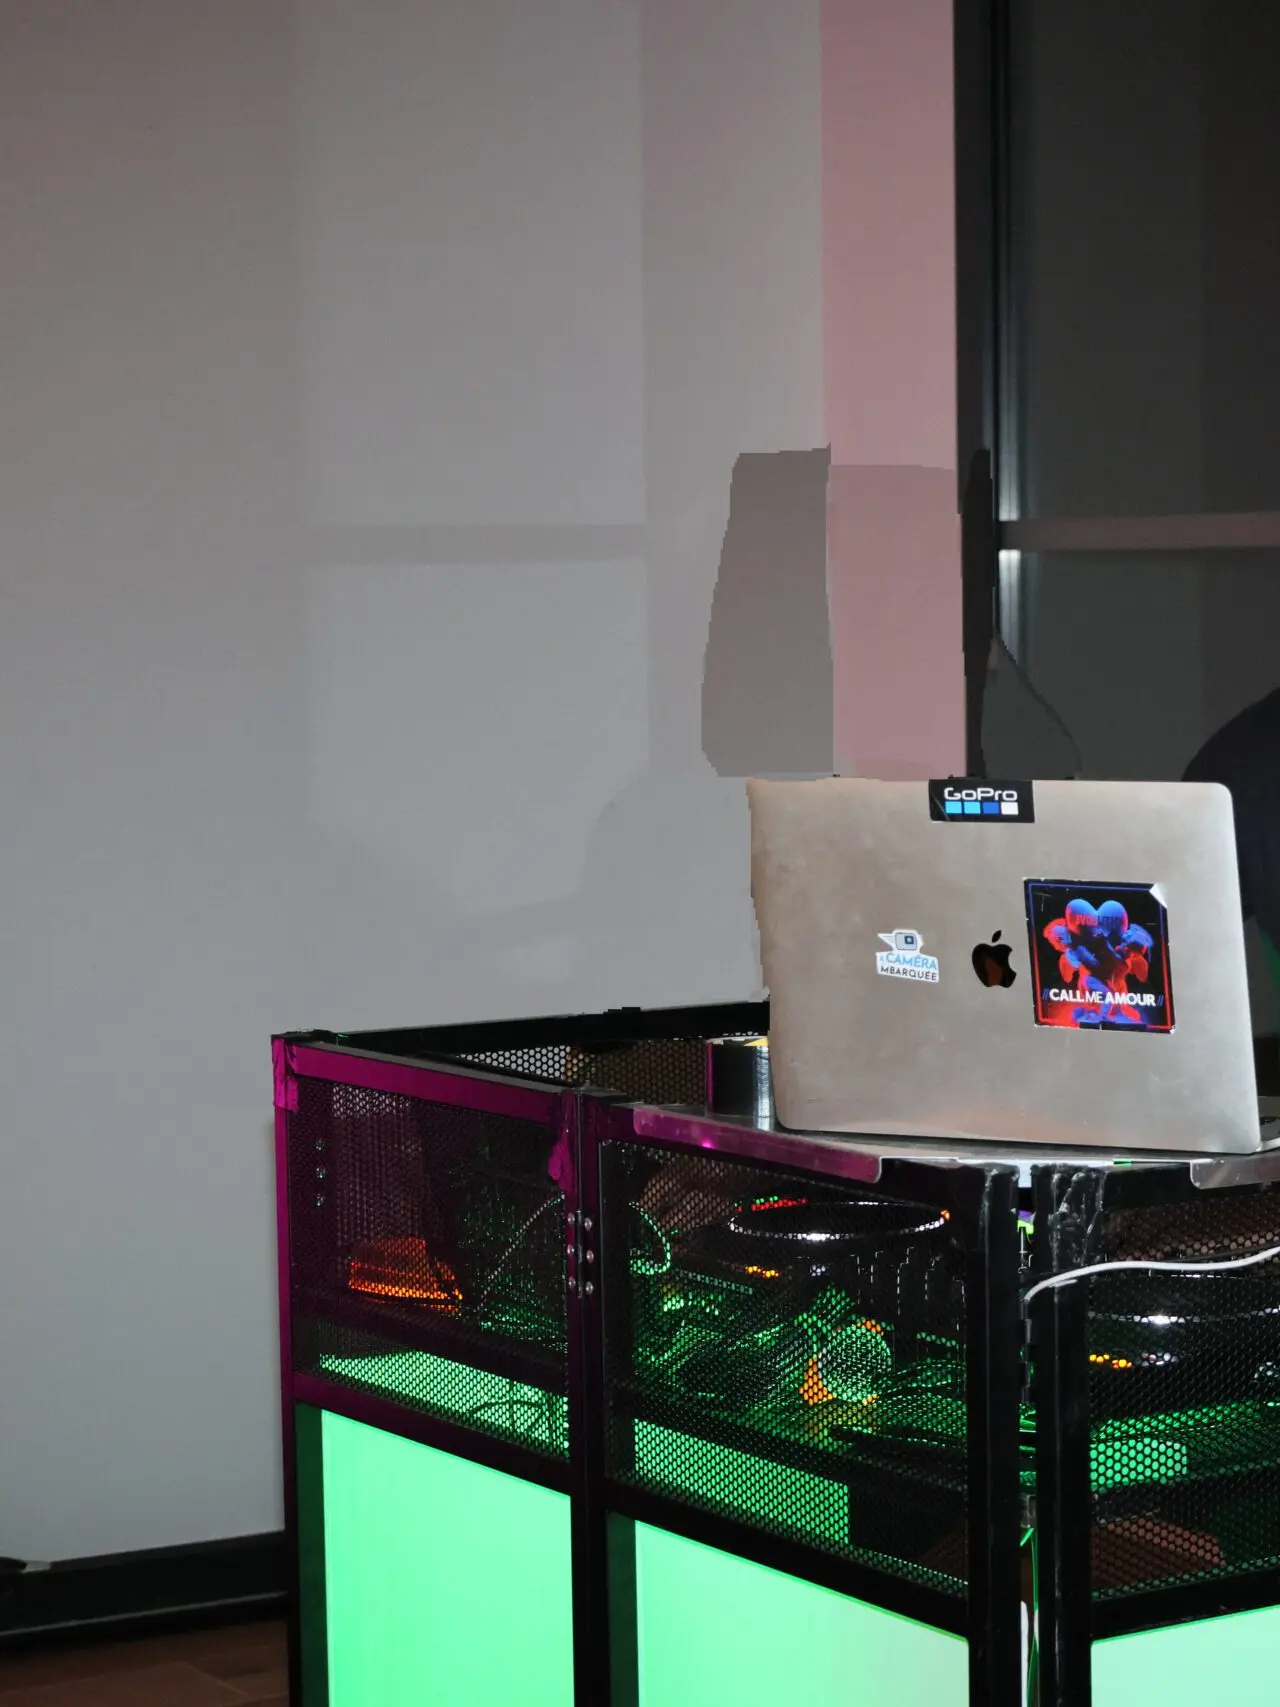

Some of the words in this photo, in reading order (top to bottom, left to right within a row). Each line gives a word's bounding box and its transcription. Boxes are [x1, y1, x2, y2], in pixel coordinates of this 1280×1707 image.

[944, 786, 1018, 802] GoPro
[1049, 988, 1085, 1003] CALL
[1086, 991, 1104, 1004] ME
[1105, 992, 1156, 1007] AMOUR
